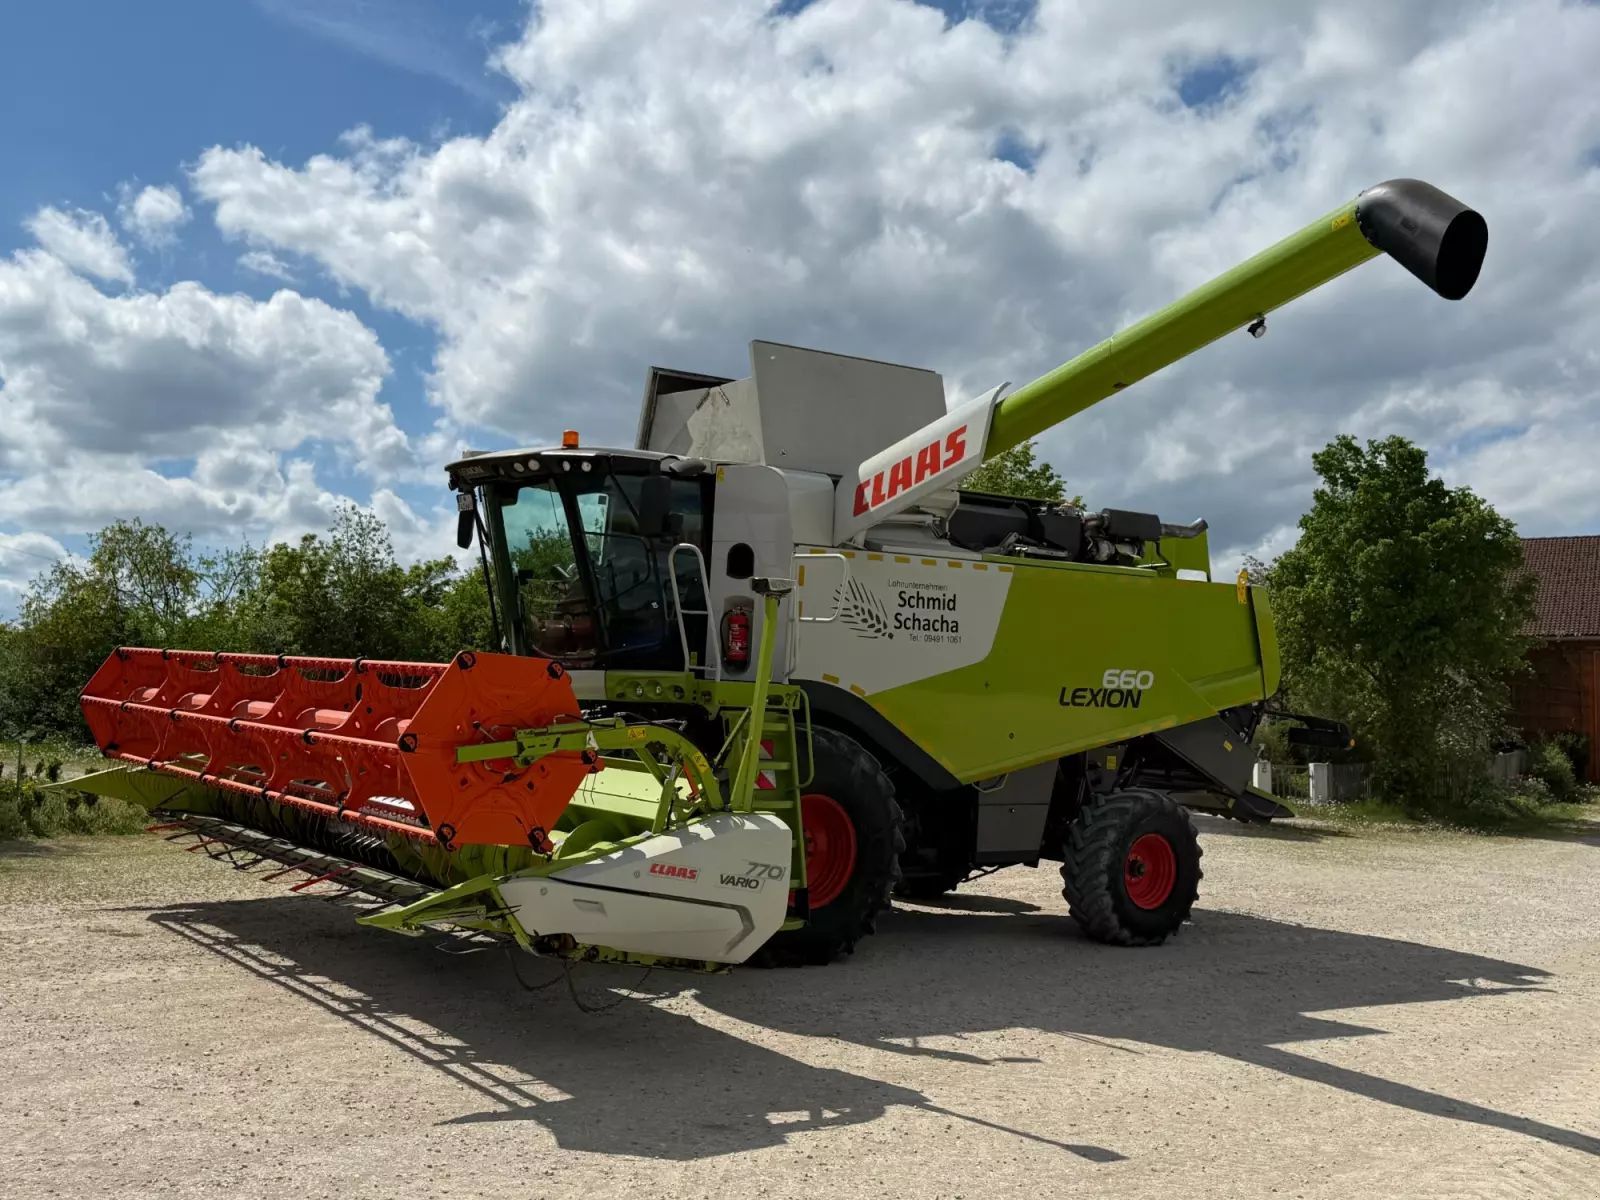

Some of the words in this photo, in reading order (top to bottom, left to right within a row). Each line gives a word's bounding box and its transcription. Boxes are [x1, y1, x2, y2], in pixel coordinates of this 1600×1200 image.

[853, 424, 968, 517] CLAAS
[888, 579, 949, 592] Lohnunternehmen
[897, 590, 957, 611] Schmid
[893, 612, 959, 633] Schacha
[924, 634, 944, 643] 09491
[1102, 669, 1154, 690] 660
[1058, 686, 1142, 708] LEXION
[649, 863, 698, 880] CLAAS
[744, 861, 784, 880] 770
[719, 874, 760, 889] VARIO
